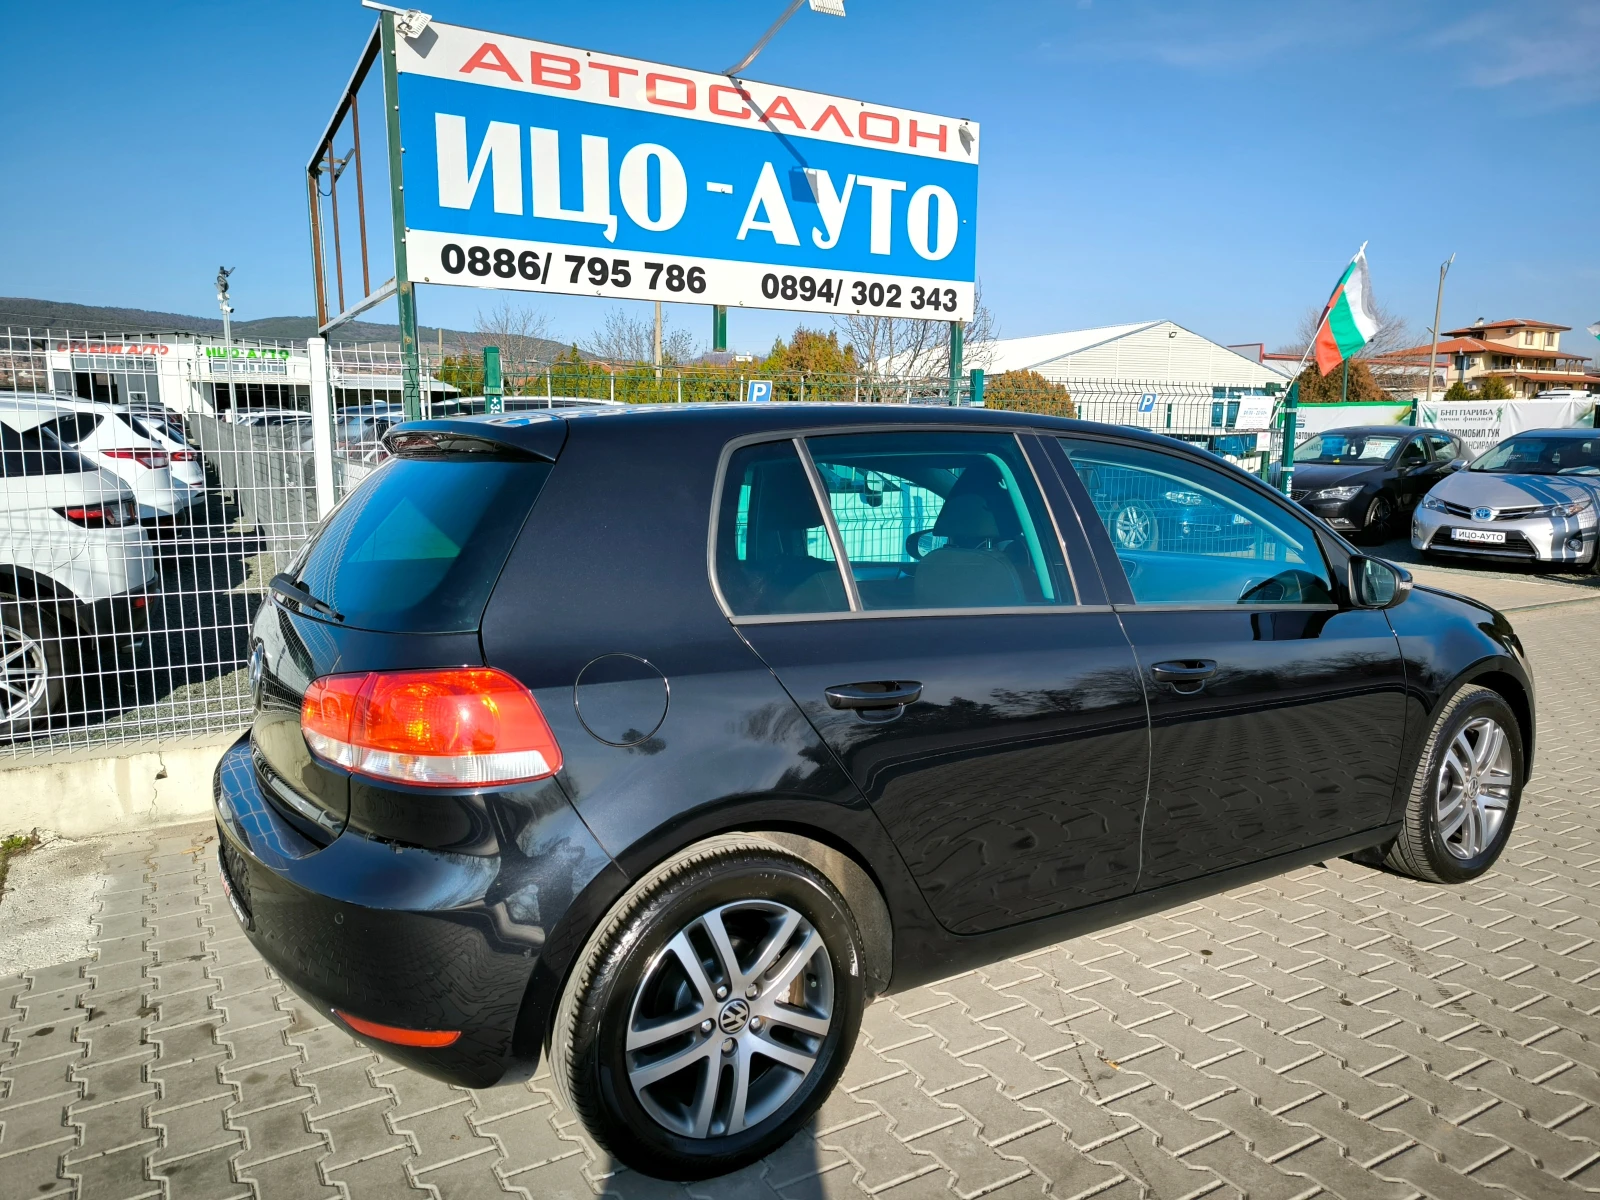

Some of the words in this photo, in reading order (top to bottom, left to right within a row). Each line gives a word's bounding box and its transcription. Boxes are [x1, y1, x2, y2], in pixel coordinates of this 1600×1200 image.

[459, 42, 947, 152] АВТОСАЛОН
[435, 112, 688, 243] ИЦО
[441, 243, 552, 285] 0886/
[564, 254, 632, 287] 795
[644, 262, 707, 294] 786
[761, 273, 843, 306] 0894/
[851, 281, 902, 308] 302
[910, 286, 958, 312] 343
[1488, 429, 1501, 438] ТУК
[1458, 530, 1504, 541] ИЦО-АУТО
